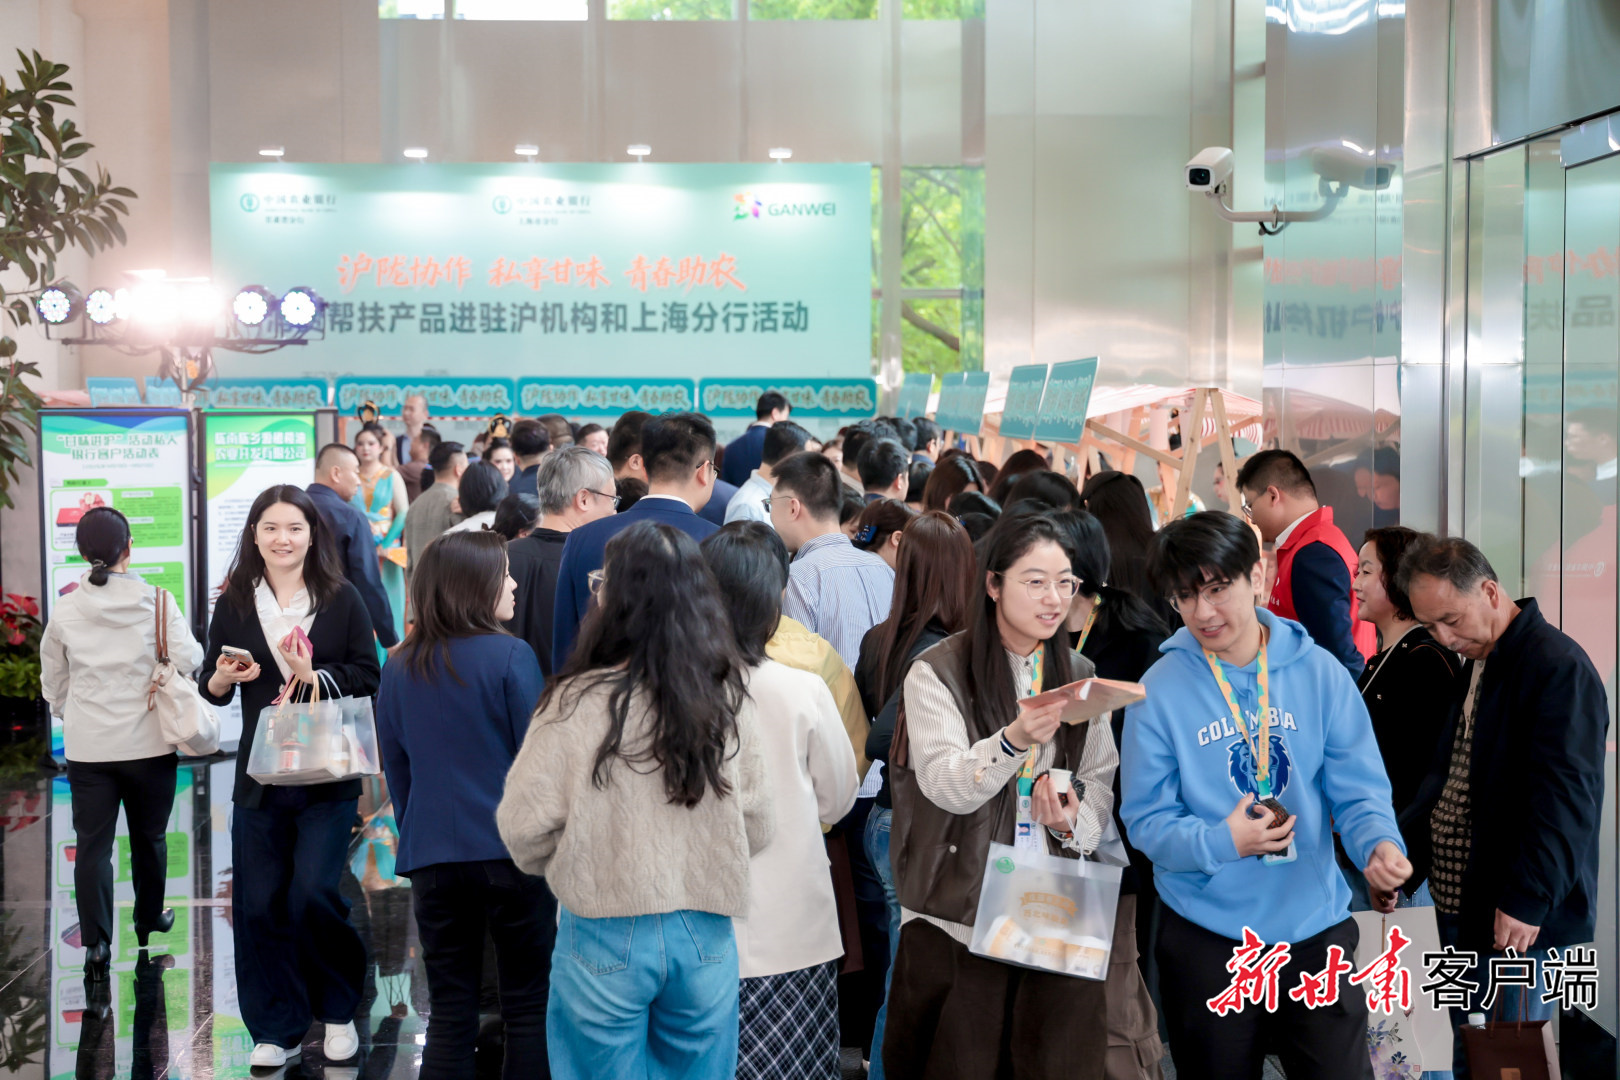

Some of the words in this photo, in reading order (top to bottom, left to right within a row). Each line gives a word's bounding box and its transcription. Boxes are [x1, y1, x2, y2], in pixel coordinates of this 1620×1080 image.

[768, 203, 836, 216] GANWEI
[337, 252, 472, 295] 沪陇协作
[489, 255, 612, 291] 私享甘味
[624, 252, 747, 295] 青春助农
[271, 300, 809, 334] 帮扶产品进驻沪机构和上海分行活动
[1197, 706, 1298, 747] COLMBA
